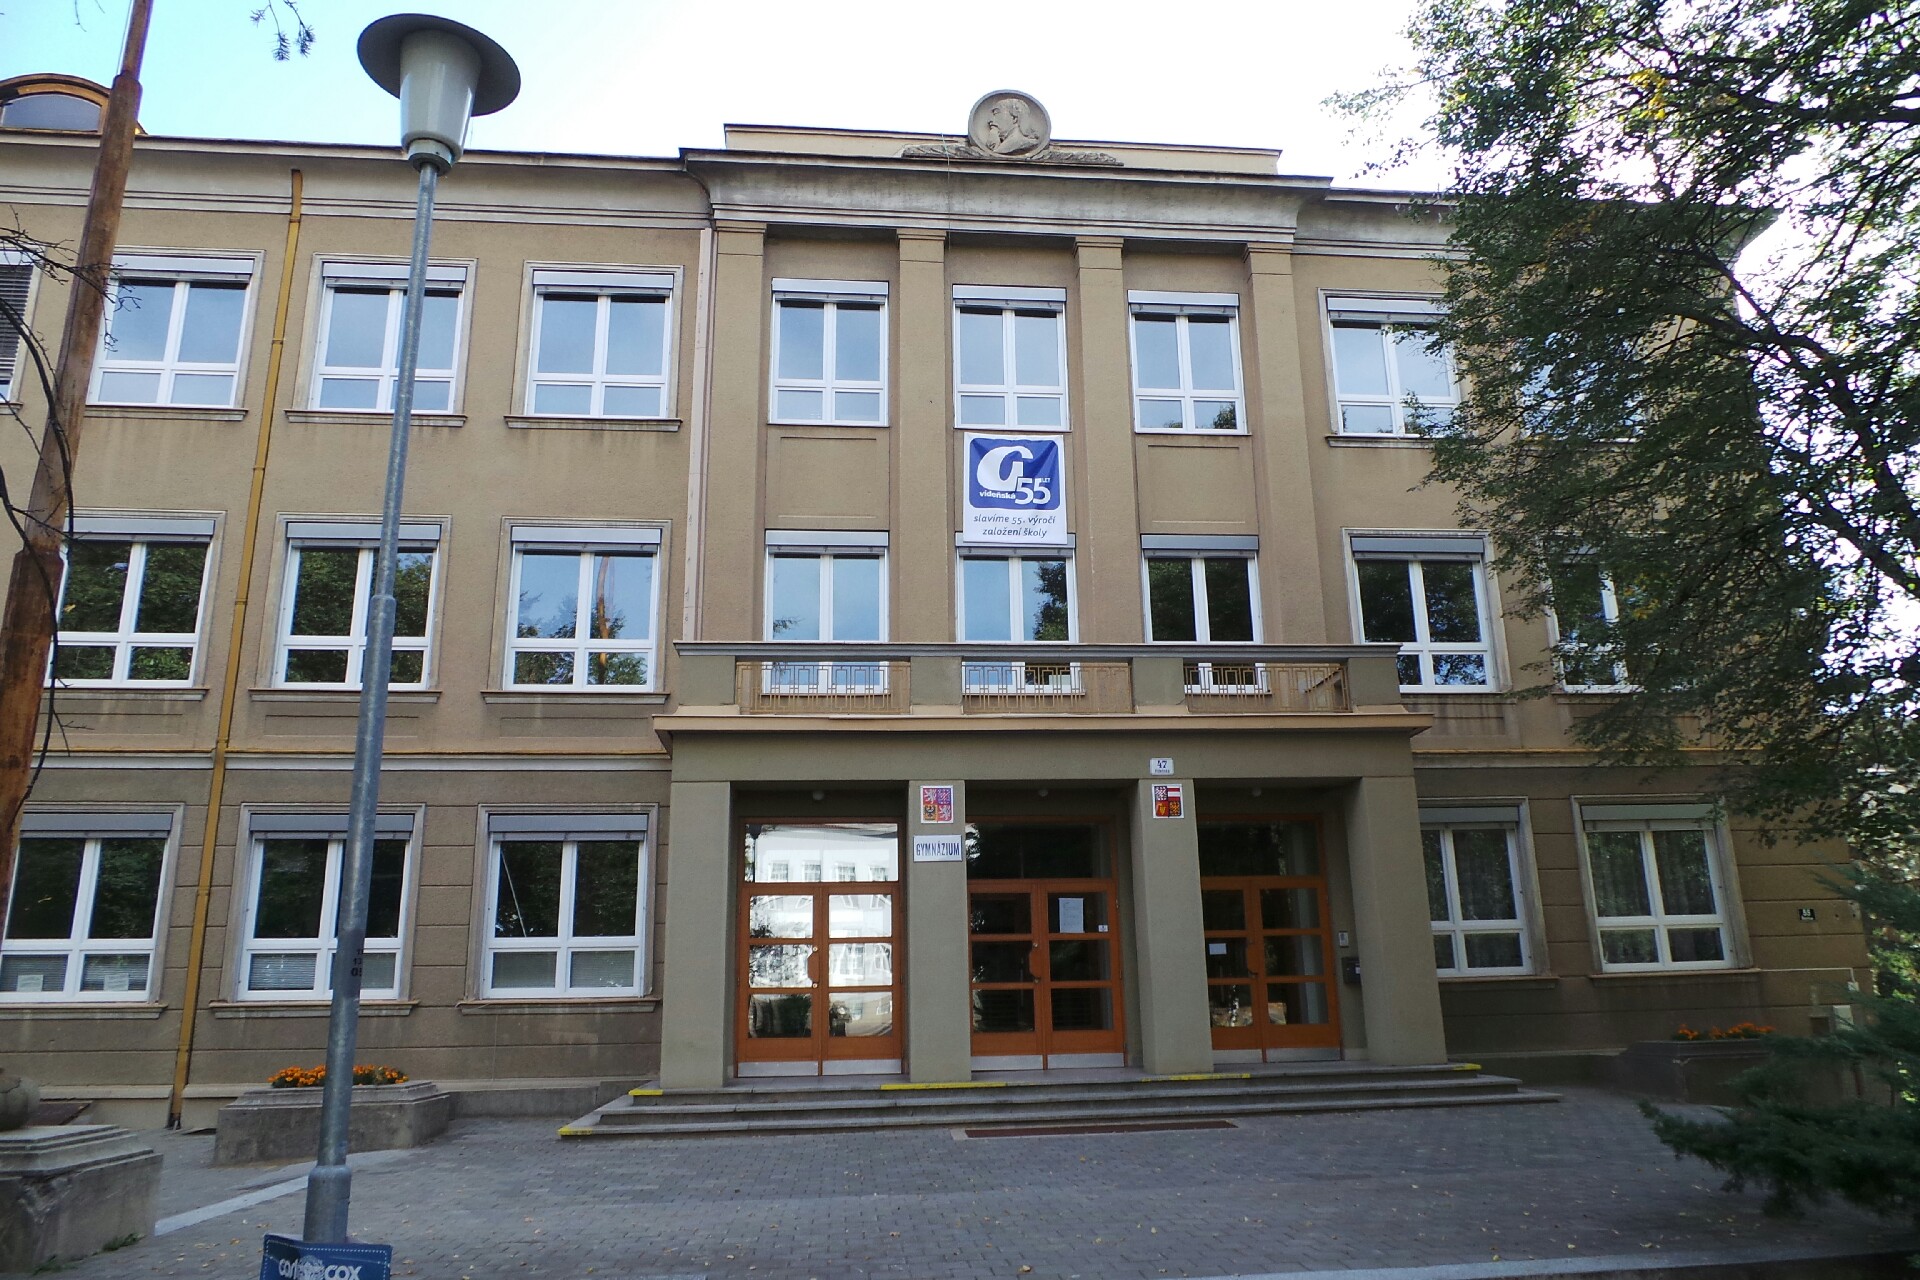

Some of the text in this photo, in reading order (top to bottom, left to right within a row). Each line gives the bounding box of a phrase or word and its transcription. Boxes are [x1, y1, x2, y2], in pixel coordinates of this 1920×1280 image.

[976, 445, 1034, 492] G
[1014, 477, 1051, 505] 55
[973, 513, 1056, 526] slavíme 55. výročí
[982, 526, 1047, 539] založení školy
[1157, 760, 1168, 769] 47
[916, 840, 960, 856] GYMNÁZIUM
